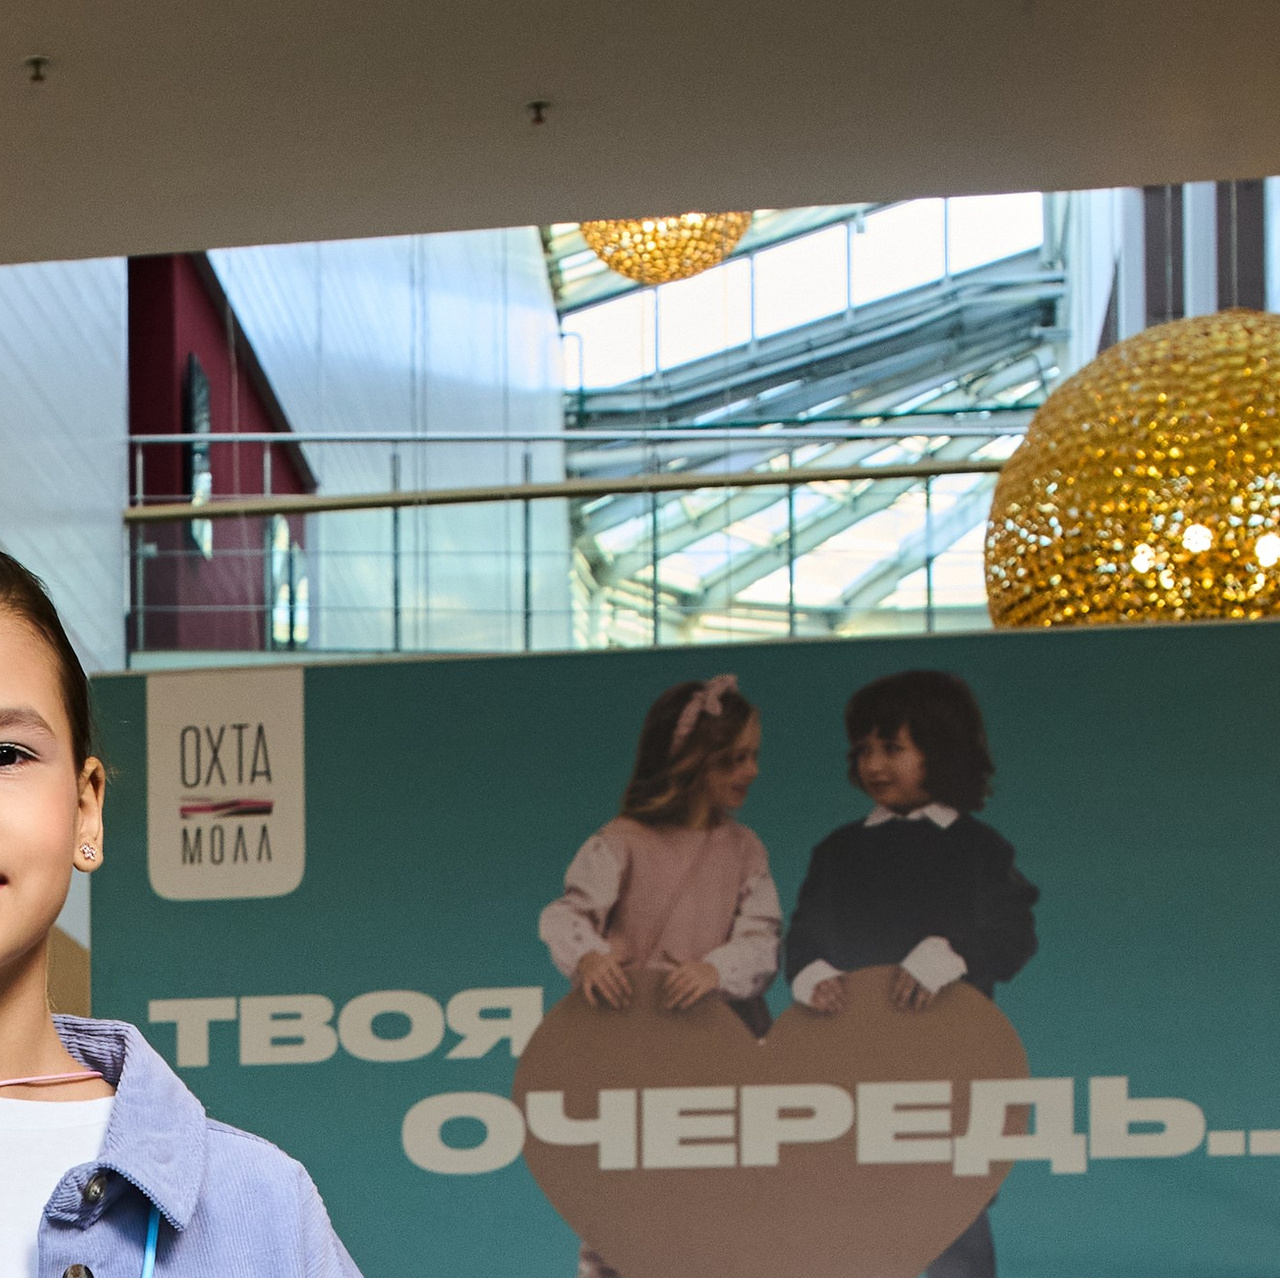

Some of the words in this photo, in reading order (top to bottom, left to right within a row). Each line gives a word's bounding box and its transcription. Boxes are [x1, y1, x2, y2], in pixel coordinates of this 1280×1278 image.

[179, 722, 273, 789] ОХТА
[181, 823, 273, 866] МОЛЛ
[147, 985, 545, 1068] ТВОЯ
